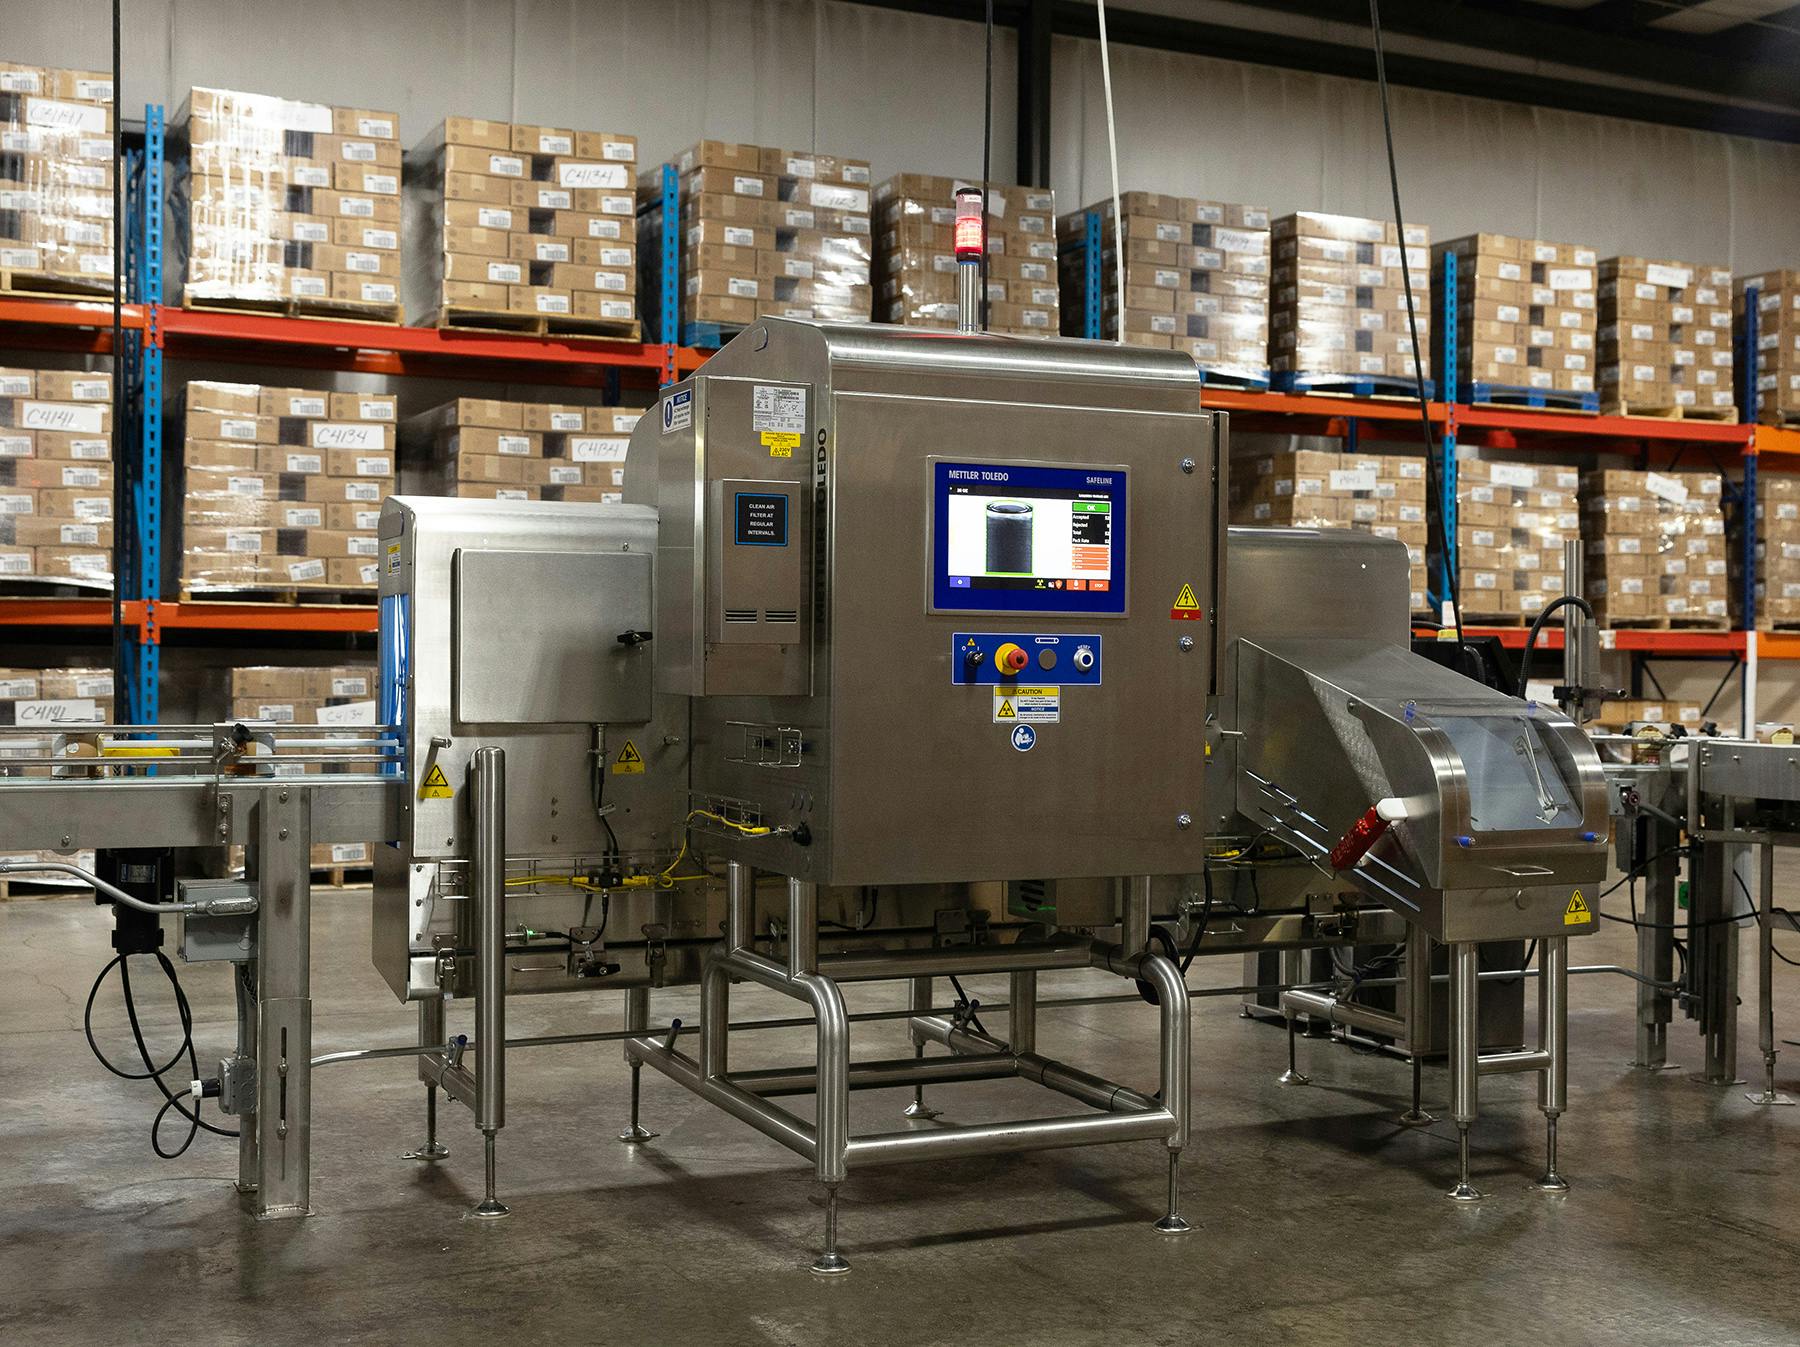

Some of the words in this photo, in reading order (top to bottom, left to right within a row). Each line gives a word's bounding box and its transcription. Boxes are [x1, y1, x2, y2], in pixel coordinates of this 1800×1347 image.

[817, 428, 827, 515] TOLEDO
[948, 470, 979, 480] METTLER
[981, 471, 1009, 481] TOLEDO
[1086, 476, 1112, 485] SAFELINE
